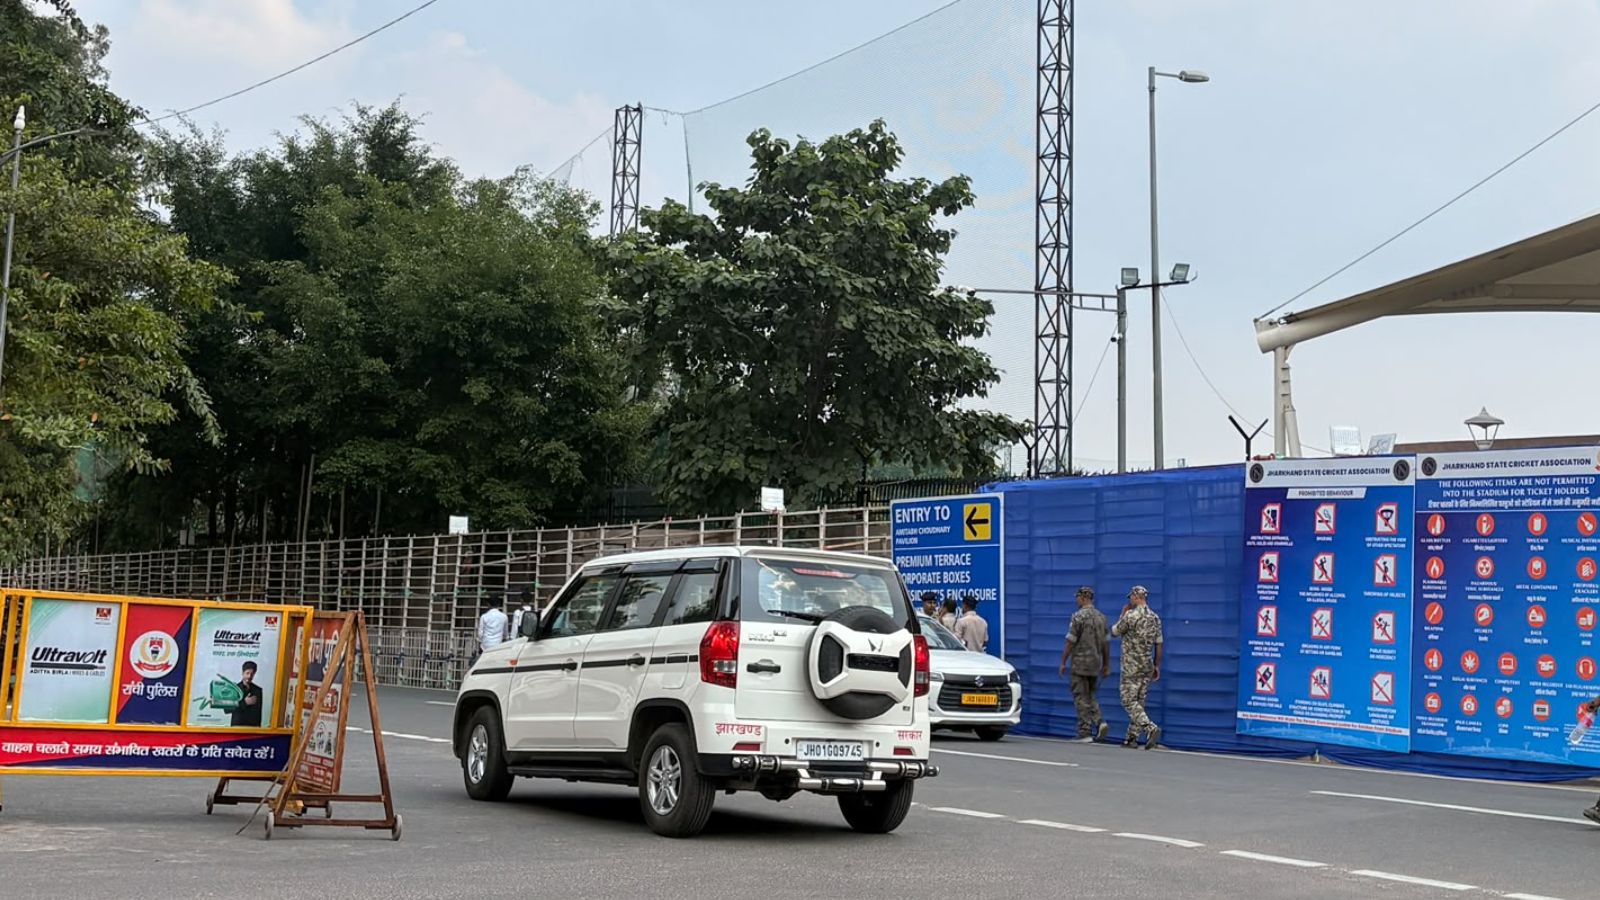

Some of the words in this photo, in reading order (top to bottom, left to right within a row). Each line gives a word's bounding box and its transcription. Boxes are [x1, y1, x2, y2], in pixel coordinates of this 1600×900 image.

[1348, 467, 1390, 475] ASSOCIATION
[1442, 462, 1485, 470] JHARKHAND
[1507, 460, 1540, 468] CRICKET
[1439, 480, 1451, 488] THE
[1495, 478, 1517, 487] ITEMS
[1519, 478, 1533, 486] ARE
[1535, 478, 1550, 486] NOT
[1552, 476, 1595, 485] PERMITTED
[1476, 489, 1509, 497] STADIUM
[1510, 488, 1525, 496] FOR
[1527, 488, 1553, 496] TICKET
[1555, 487, 1590, 495] HOLDERS
[895, 506, 931, 523] ENTRY
[934, 505, 950, 521] TO
[895, 527, 918, 536] AMITABH
[918, 526, 951, 535] CHOUDHARY
[895, 537, 918, 545] PAVILION
[895, 555, 933, 568] PREMIUM
[934, 553, 971, 566] TERRACE
[902, 572, 941, 585] ORPORATE
[943, 571, 971, 584] BOXES
[214, 630, 261, 641] Ultravolt
[31, 647, 107, 664] Ultravolt
[122, 680, 145, 696] रांची
[146, 682, 179, 700] पुलिस
[715, 722, 762, 737] झारखण्ड
[897, 729, 923, 741] सरकार
[1, 742, 33, 754] वाहन
[35, 740, 70, 754] चलाते
[72, 744, 102, 755] समय
[105, 742, 149, 756] संभावित
[152, 744, 186, 757] खतरों
[186, 744, 199, 757] के
[201, 744, 222, 759] प्रति
[224, 745, 252, 759] सचेत
